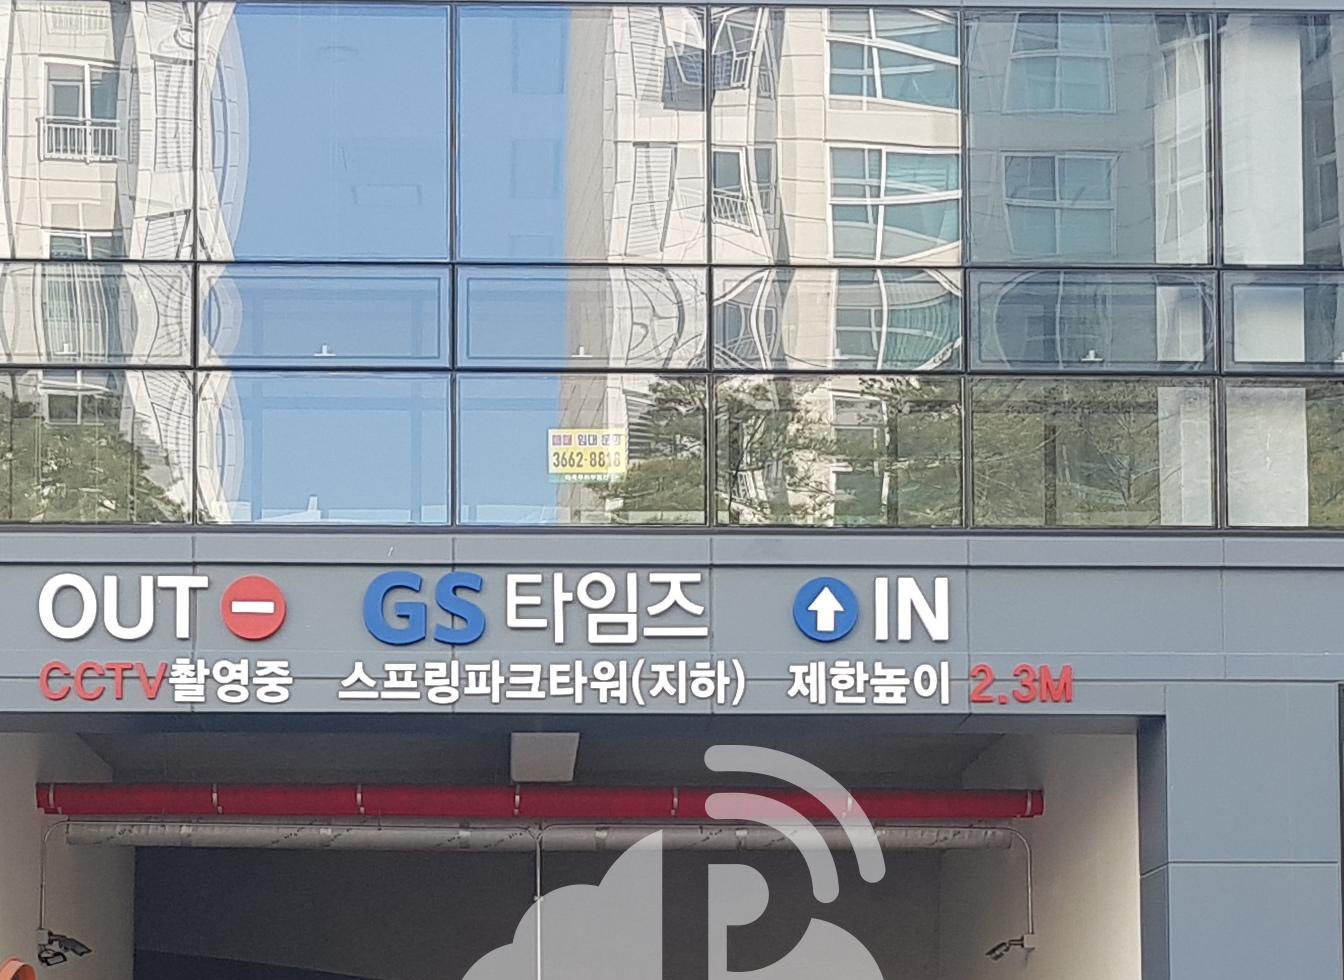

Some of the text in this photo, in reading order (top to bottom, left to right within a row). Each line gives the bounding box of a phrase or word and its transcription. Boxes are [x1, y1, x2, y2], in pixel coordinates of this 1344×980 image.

[38, 572, 209, 641] OUT
[363, 571, 709, 645] GS 타임즈
[874, 576, 950, 641] IN
[787, 660, 1075, 705] 제한높이 2.3M
